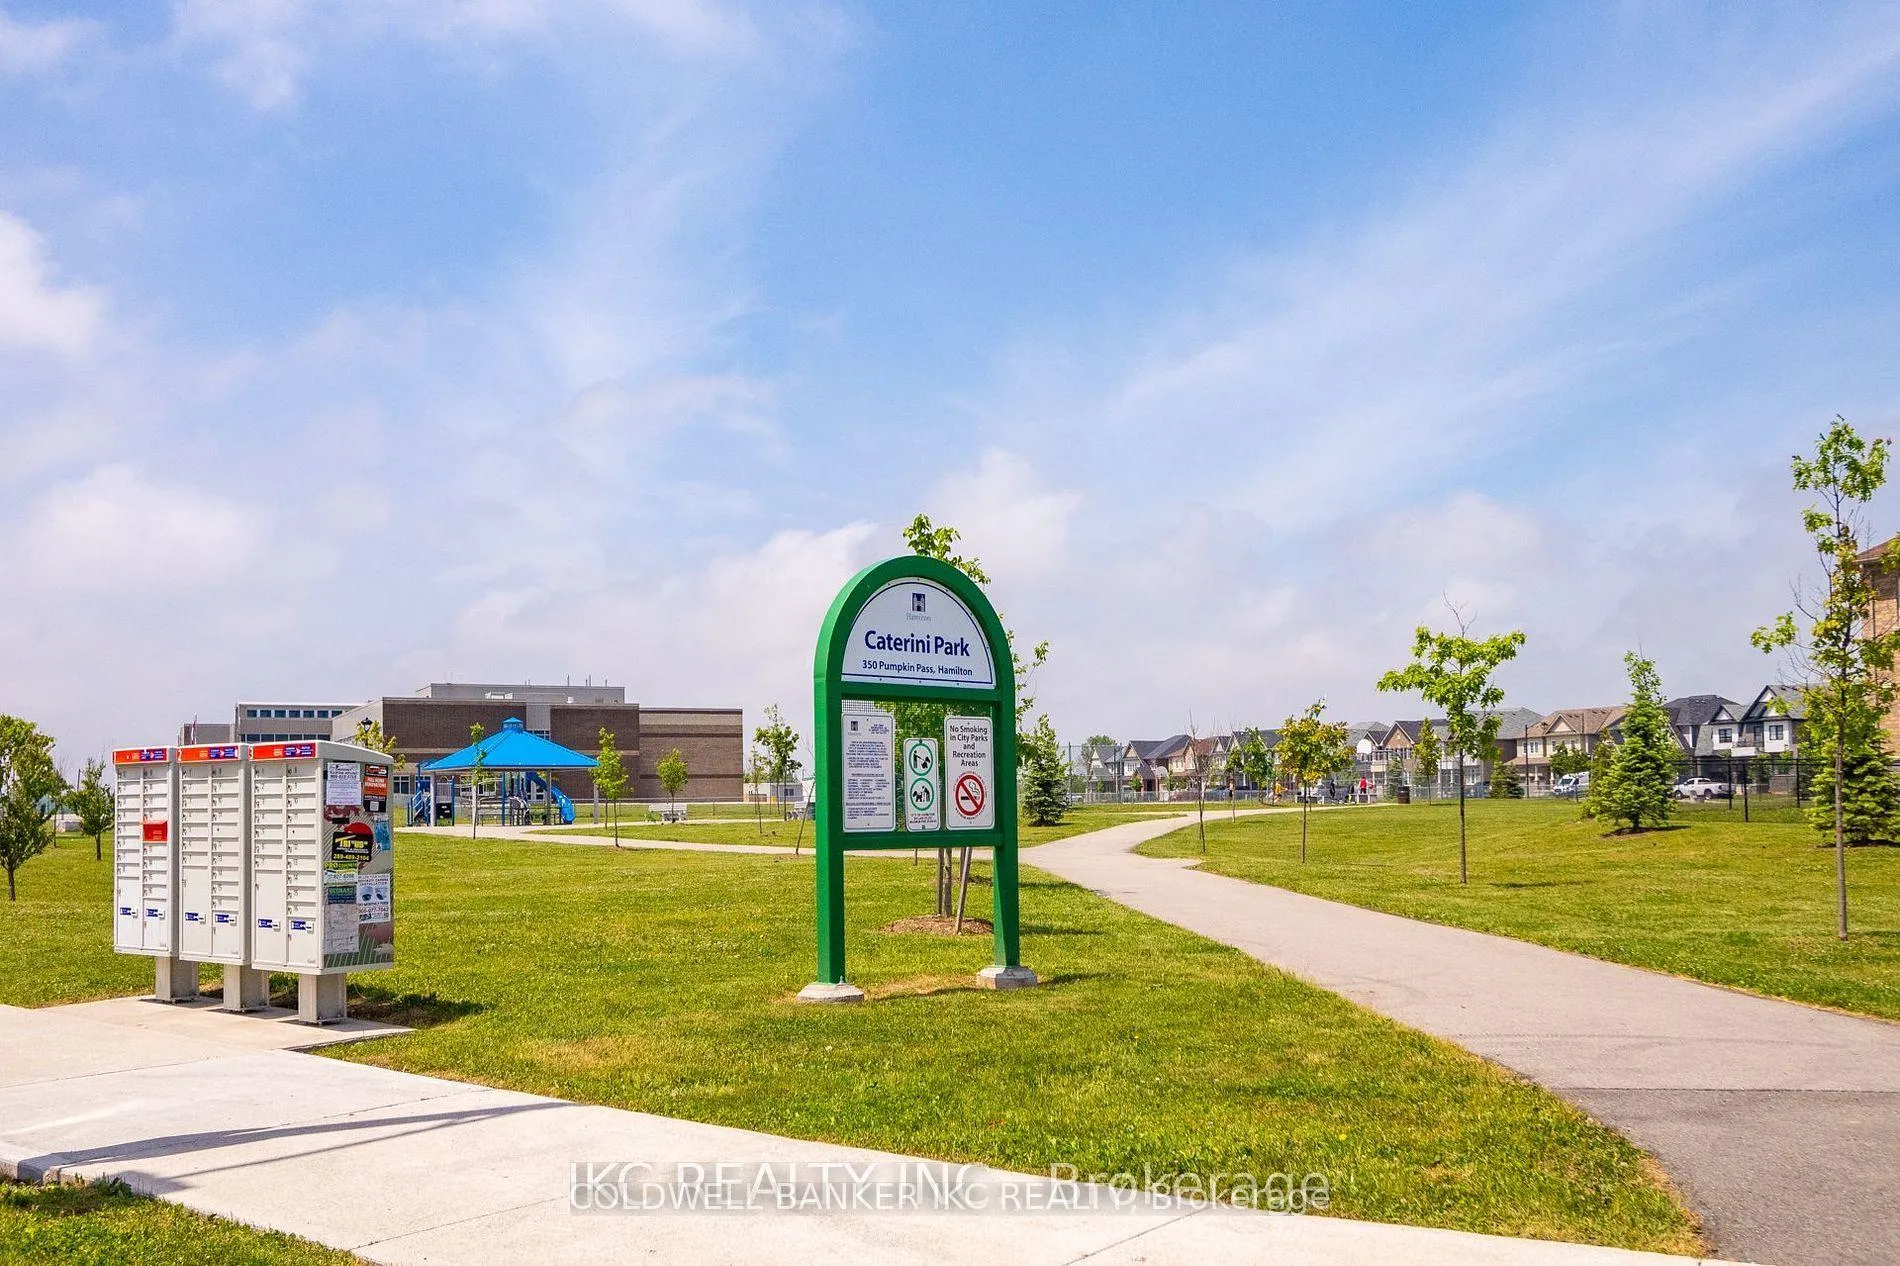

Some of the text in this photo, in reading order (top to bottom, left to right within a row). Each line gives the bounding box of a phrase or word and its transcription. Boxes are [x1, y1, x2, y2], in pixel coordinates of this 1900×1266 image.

[864, 630, 970, 656] Caterini Park
[862, 660, 973, 676] 350 Pumpkin Pass, Hamilton
[950, 725, 988, 735] No Smoking
[950, 733, 988, 743] in City Parks
[963, 742, 975, 750] and
[952, 750, 986, 759] Recreation
